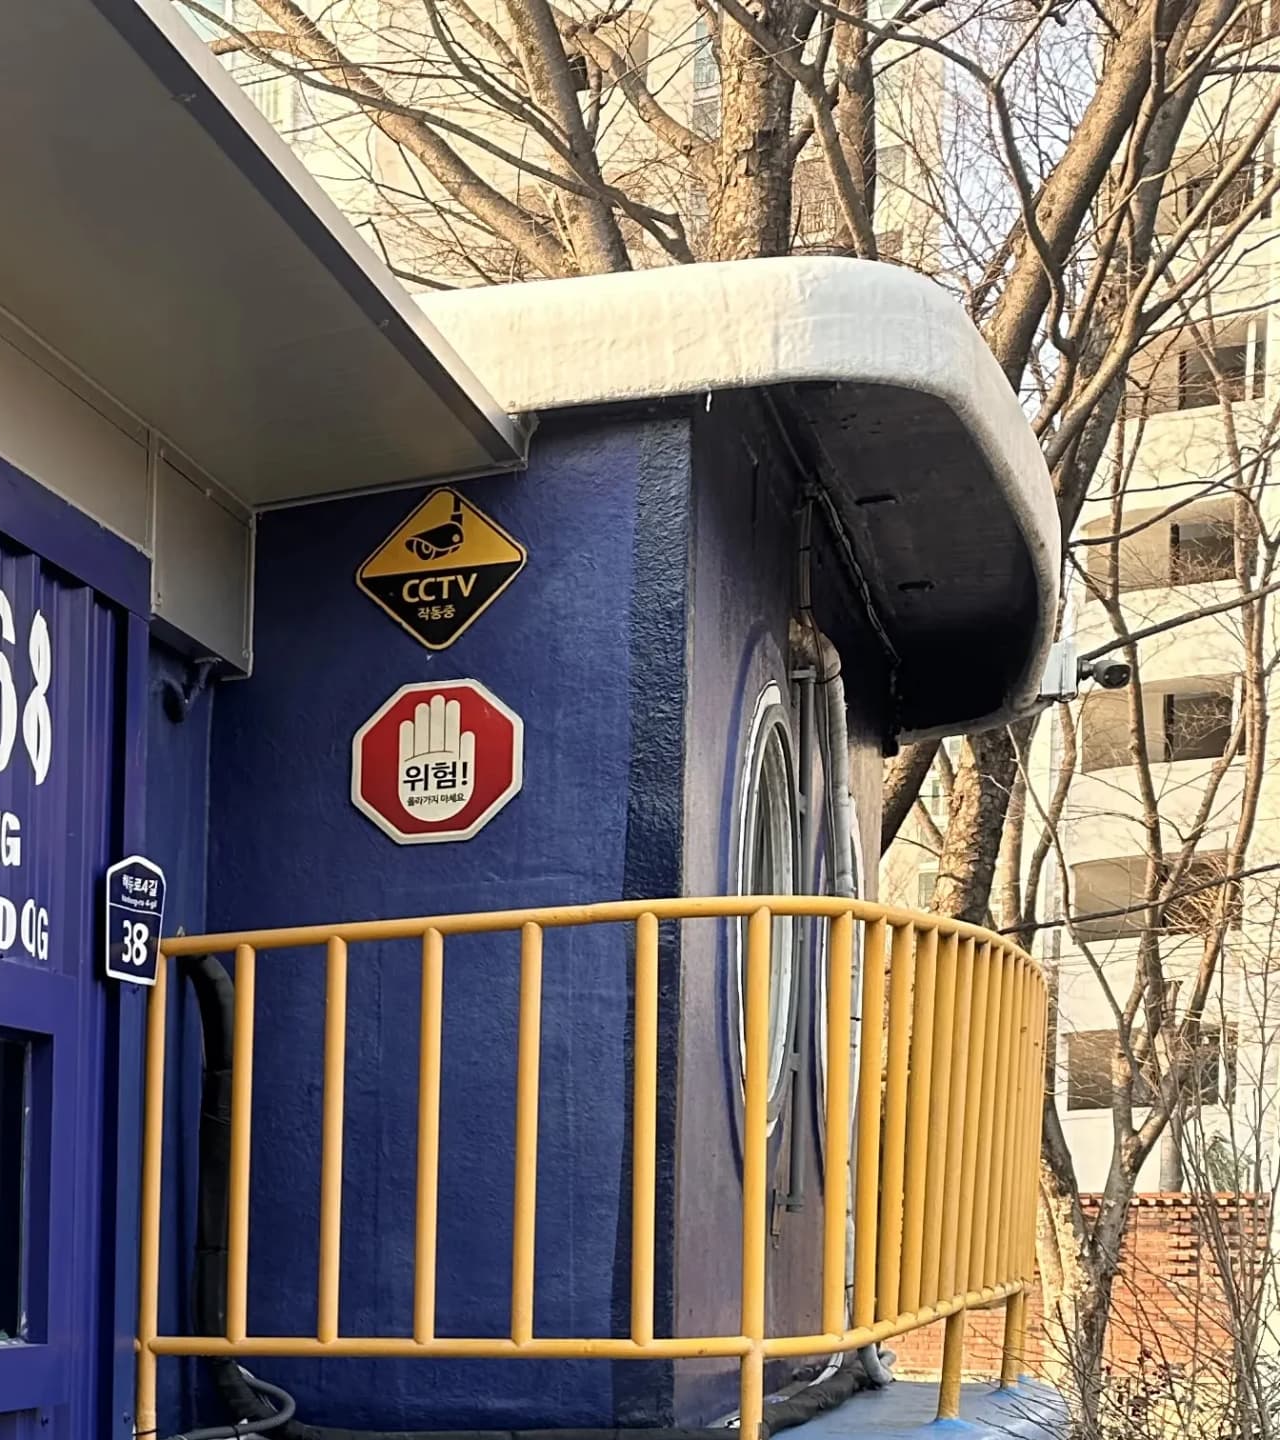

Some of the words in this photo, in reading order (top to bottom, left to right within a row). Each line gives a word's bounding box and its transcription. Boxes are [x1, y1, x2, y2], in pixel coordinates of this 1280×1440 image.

[402, 573, 478, 603] CCTV
[418, 604, 456, 620] 작동중
[403, 761, 468, 791] 위험!
[121, 919, 149, 966] 38
